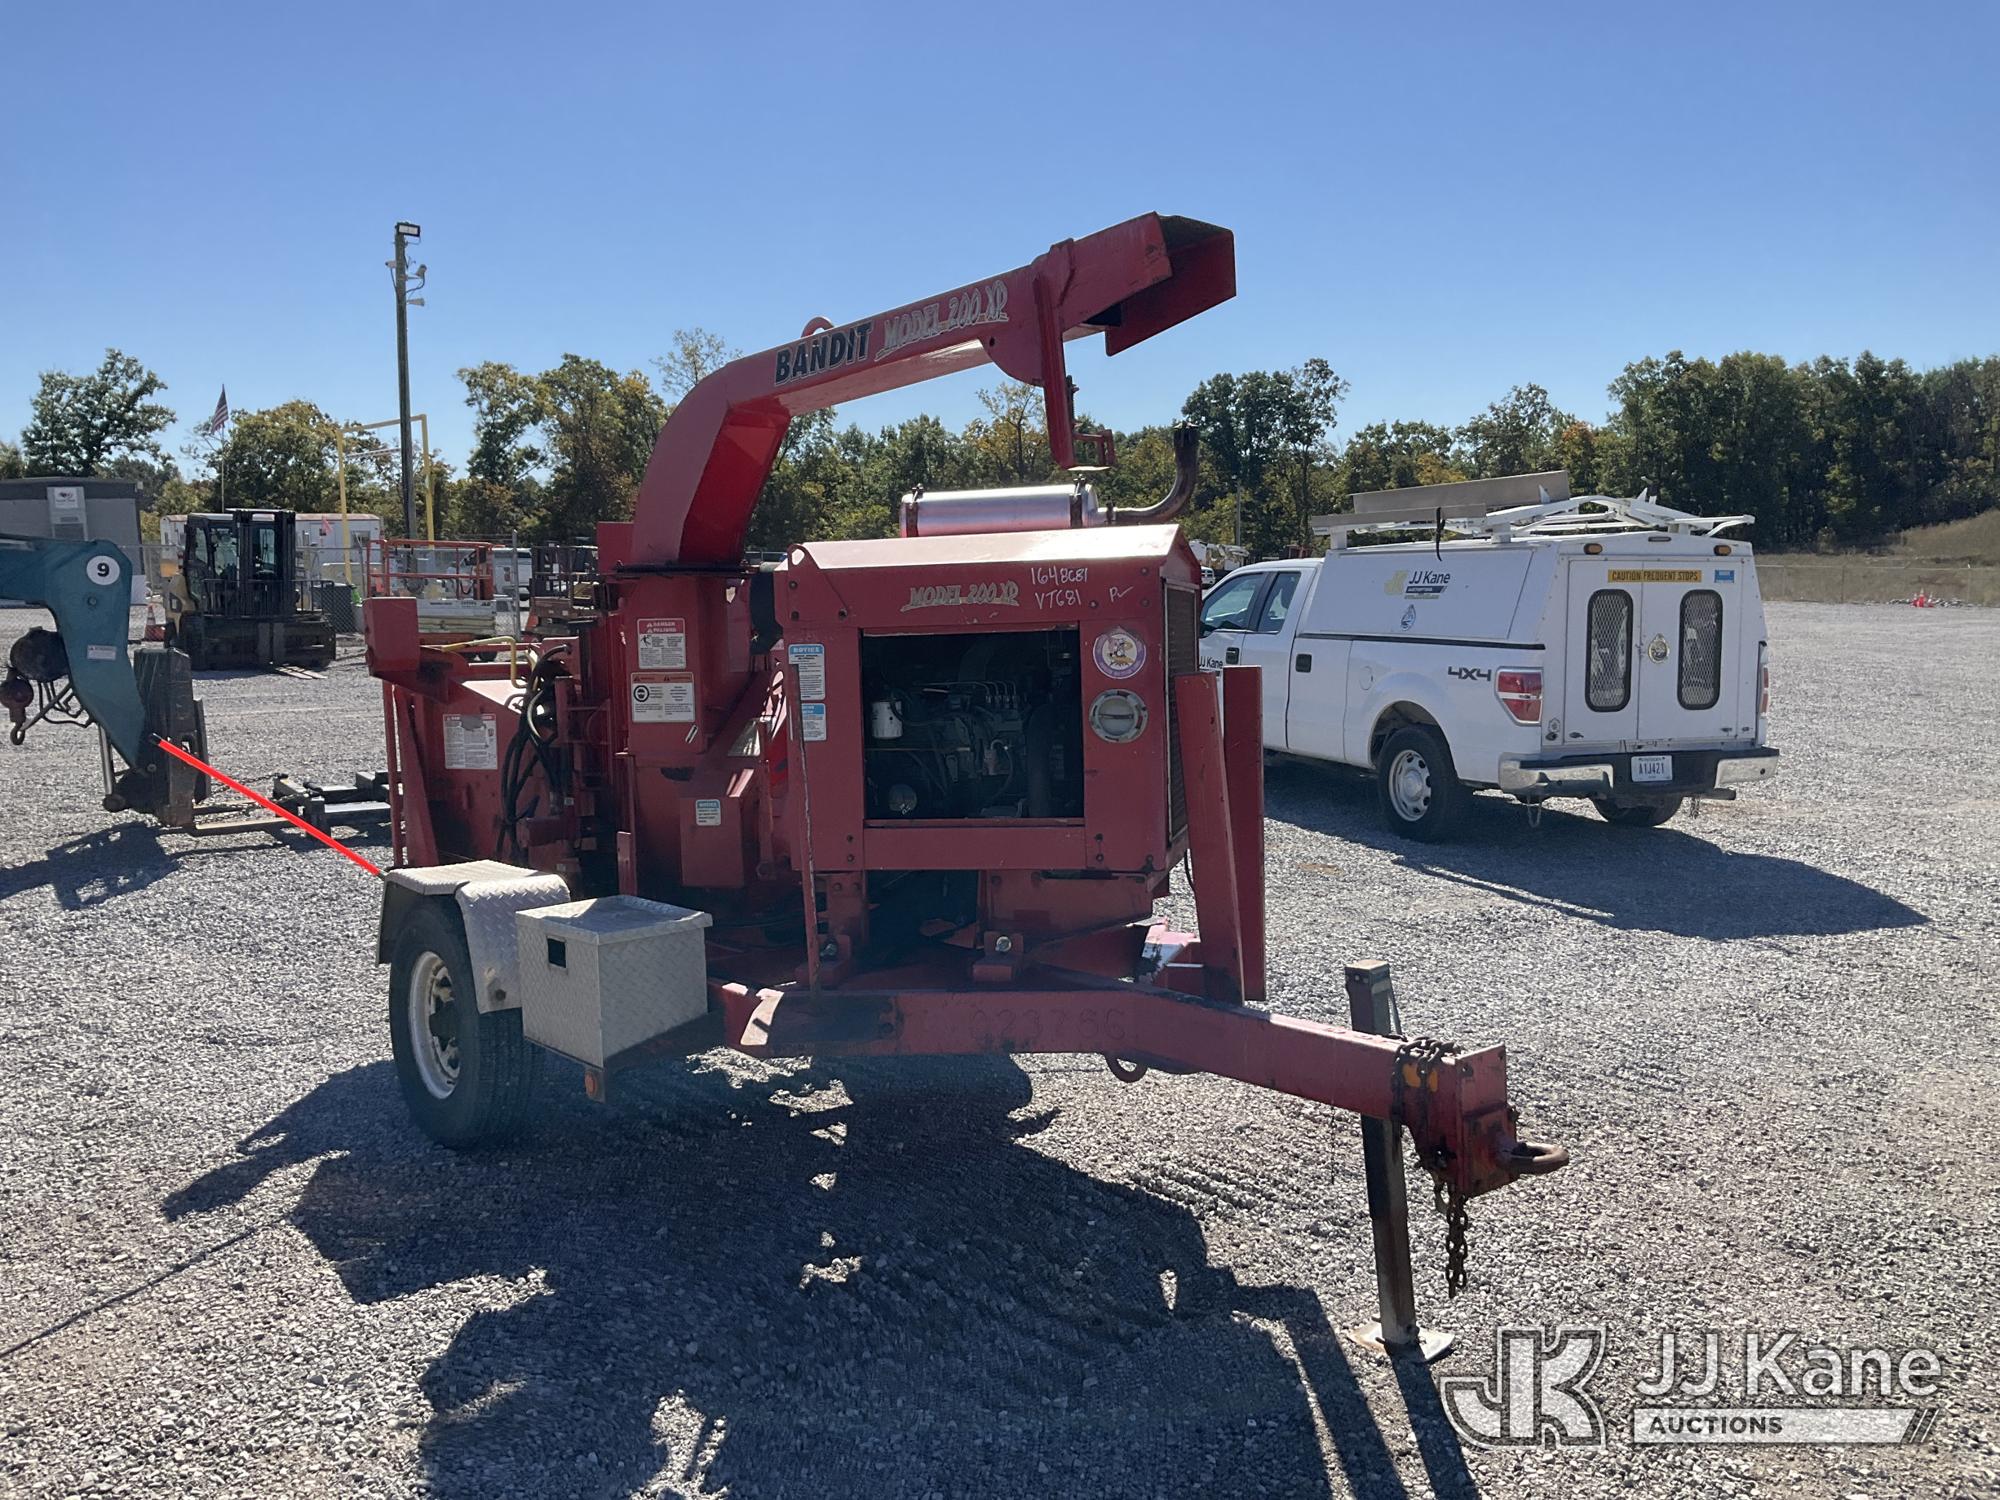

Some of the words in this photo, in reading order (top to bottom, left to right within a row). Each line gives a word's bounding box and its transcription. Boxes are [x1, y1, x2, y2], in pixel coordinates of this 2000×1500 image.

[881, 301, 941, 350] MODEL
[948, 287, 981, 329] 200
[985, 279, 1009, 319] XP
[774, 321, 874, 386] BANDIT
[97, 562, 110, 577] 9
[1611, 570, 1641, 581] CAUTION
[1643, 570, 1676, 581] FREQUENT
[1678, 570, 1699, 581] STOPS
[1409, 571, 1422, 584] JJ
[1422, 571, 1451, 584] Kane
[910, 584, 962, 607] MODEL
[967, 582, 998, 604] 200
[1000, 579, 1019, 601] XP
[1206, 657, 1223, 669] Kane
